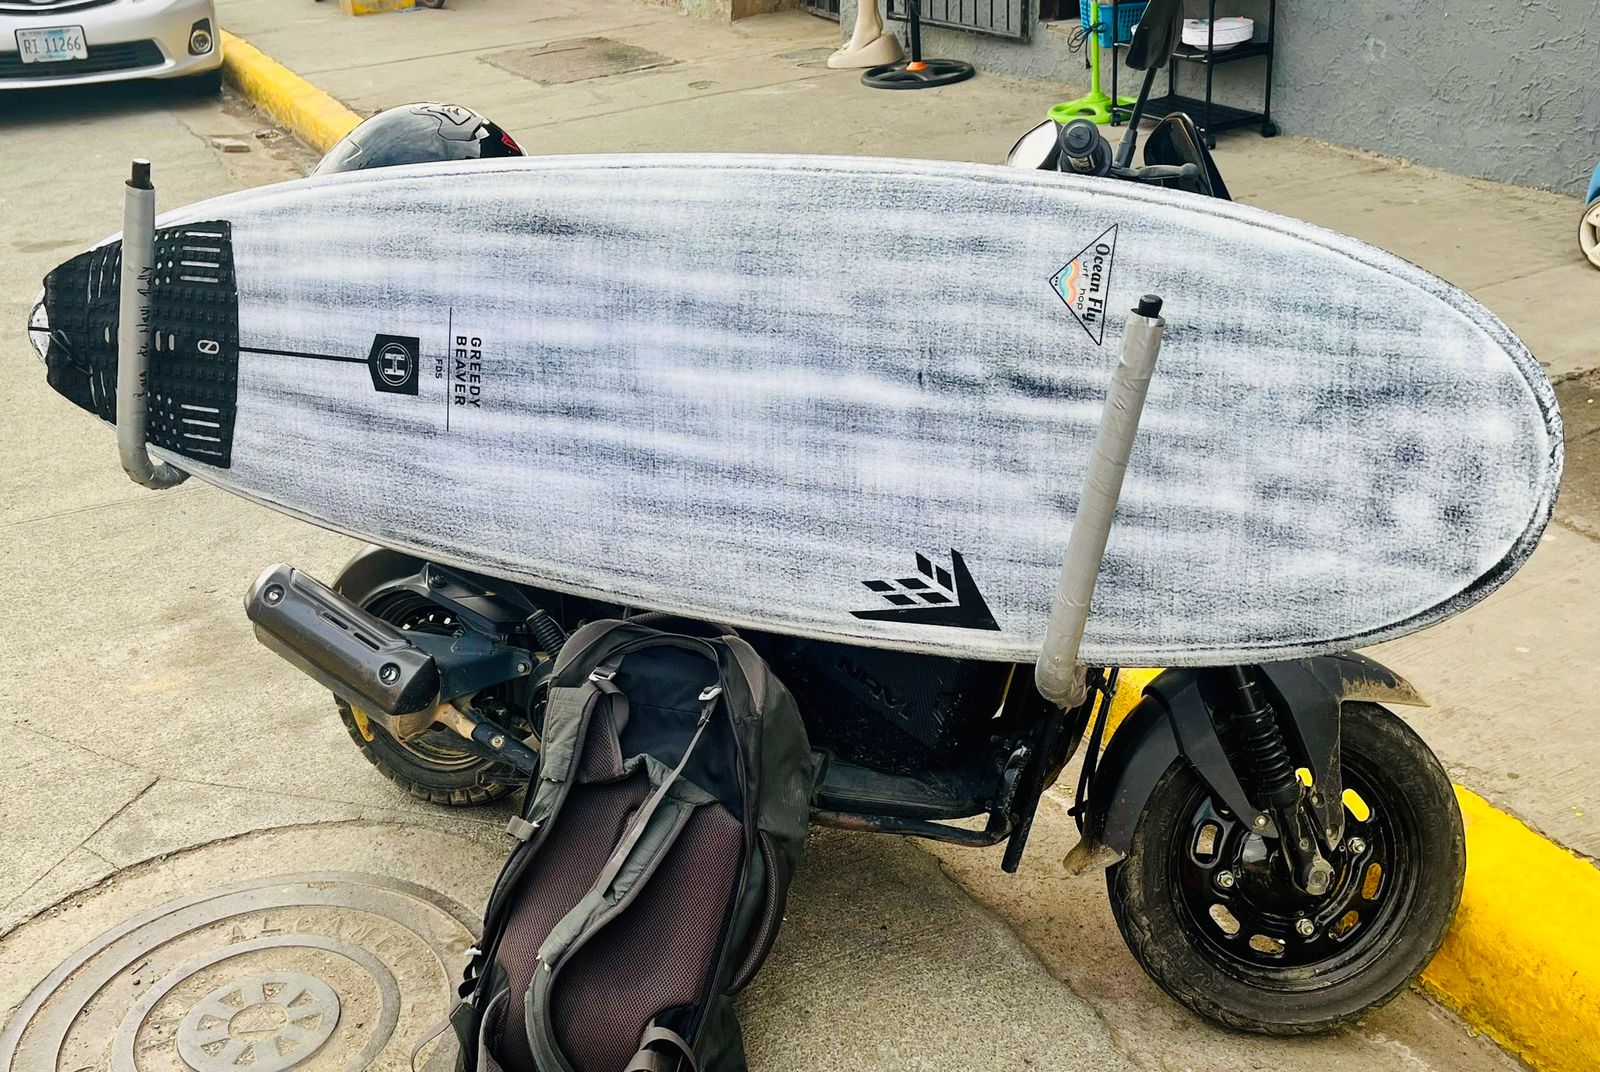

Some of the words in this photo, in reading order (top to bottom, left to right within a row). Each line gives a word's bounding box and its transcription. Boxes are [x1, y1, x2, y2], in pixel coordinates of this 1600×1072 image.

[45, 36, 81, 54] 11266
[1089, 243, 1111, 293] Ocean
[1081, 297, 1103, 323] Fly
[454, 335, 468, 406] BEAVER
[469, 336, 482, 409] GREEDY
